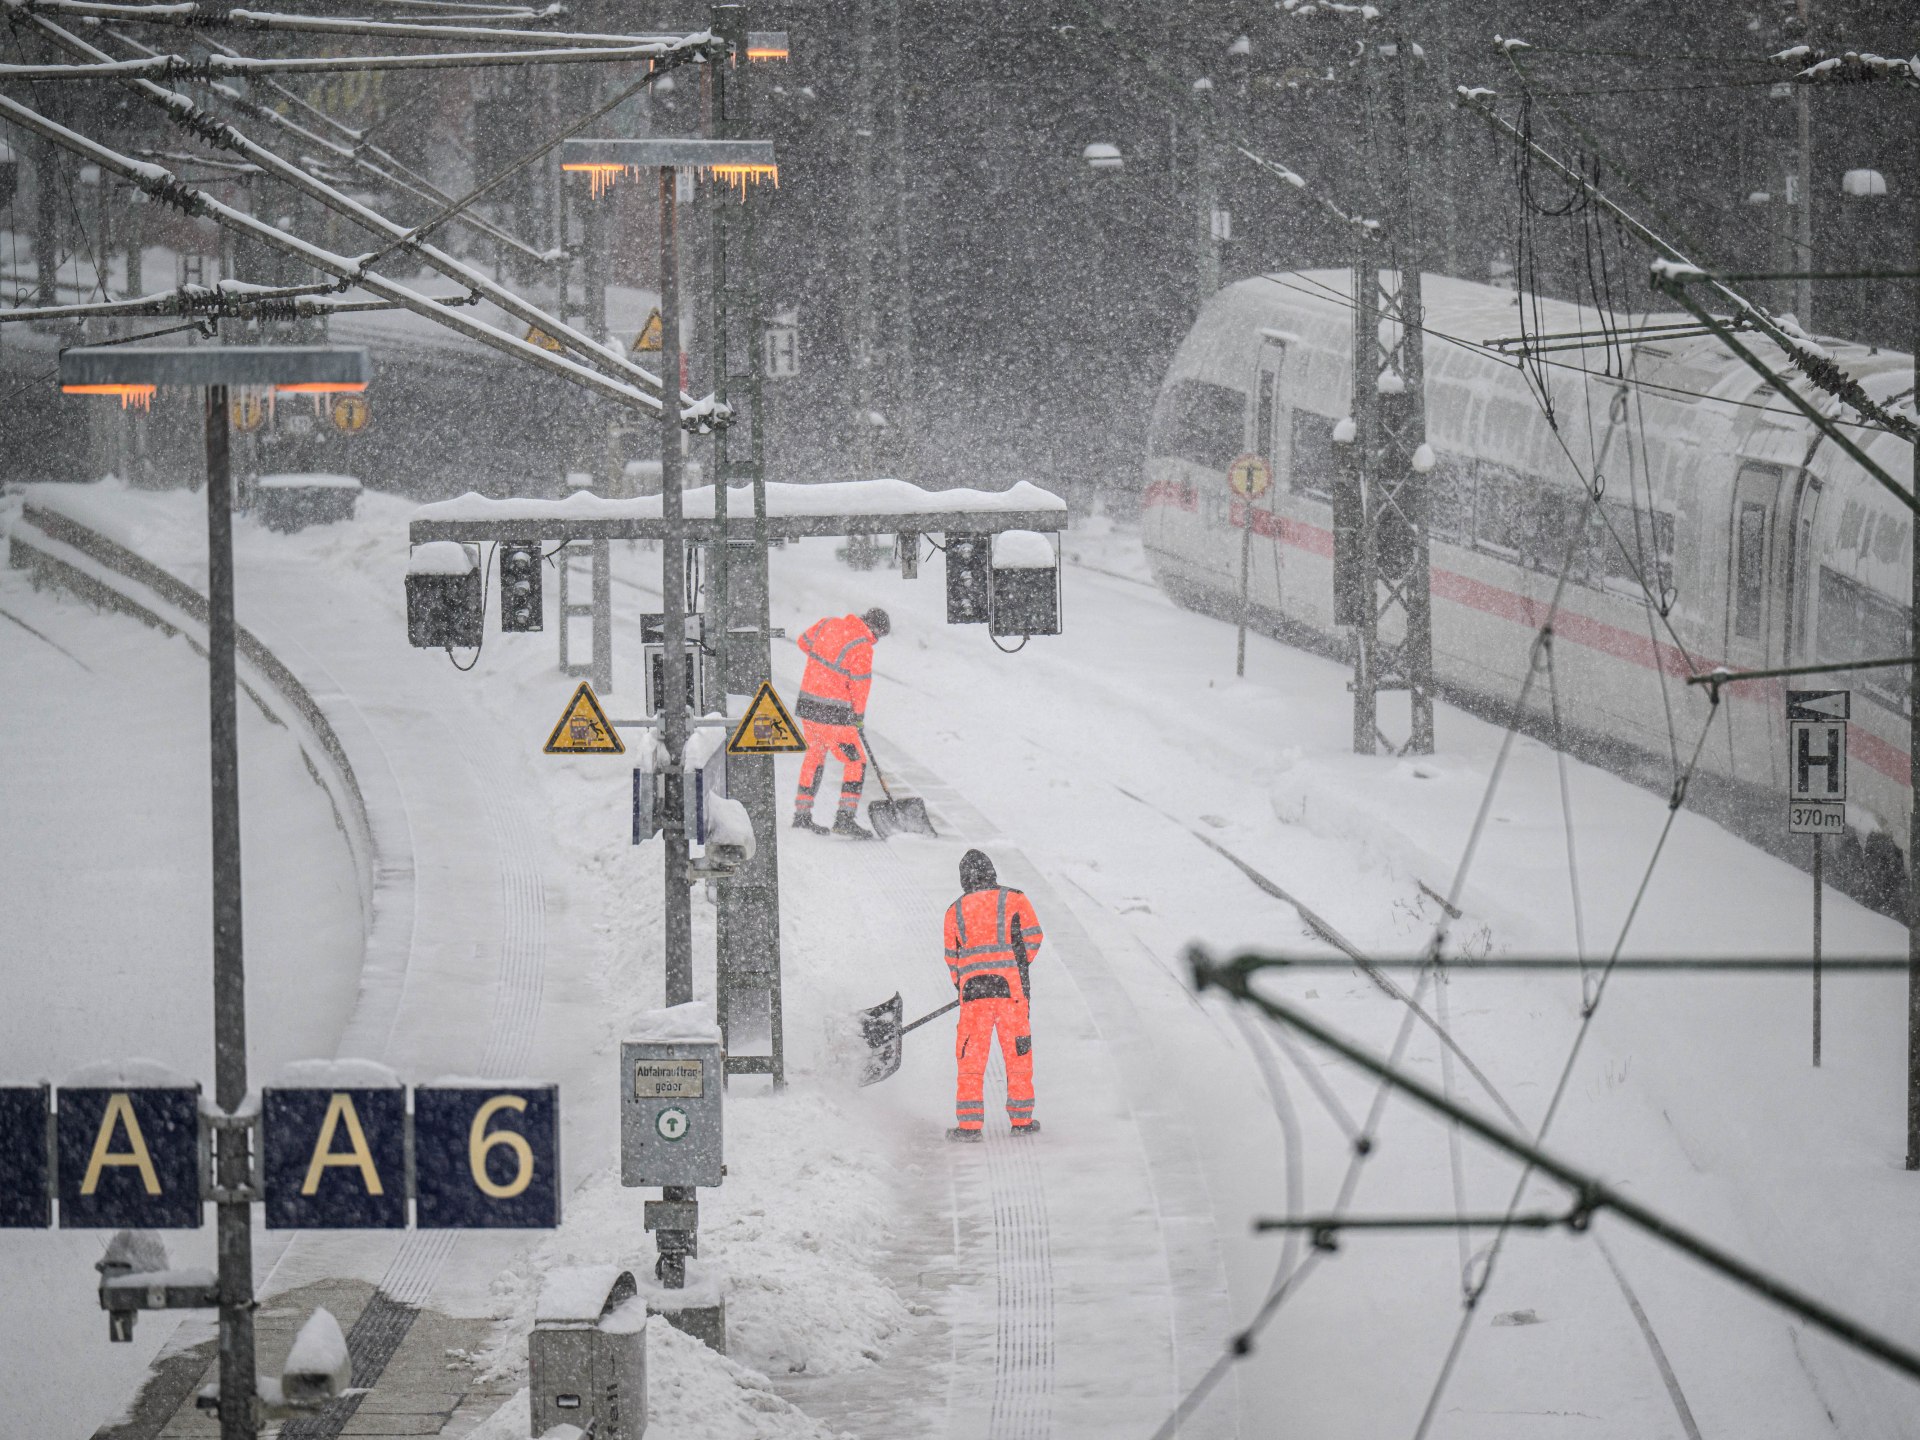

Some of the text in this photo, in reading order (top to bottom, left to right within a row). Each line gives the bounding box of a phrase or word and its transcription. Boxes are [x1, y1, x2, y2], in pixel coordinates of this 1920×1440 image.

[1798, 728, 1839, 793] H
[80, 1093, 162, 1196] A
[301, 1093, 535, 1198] A 6
